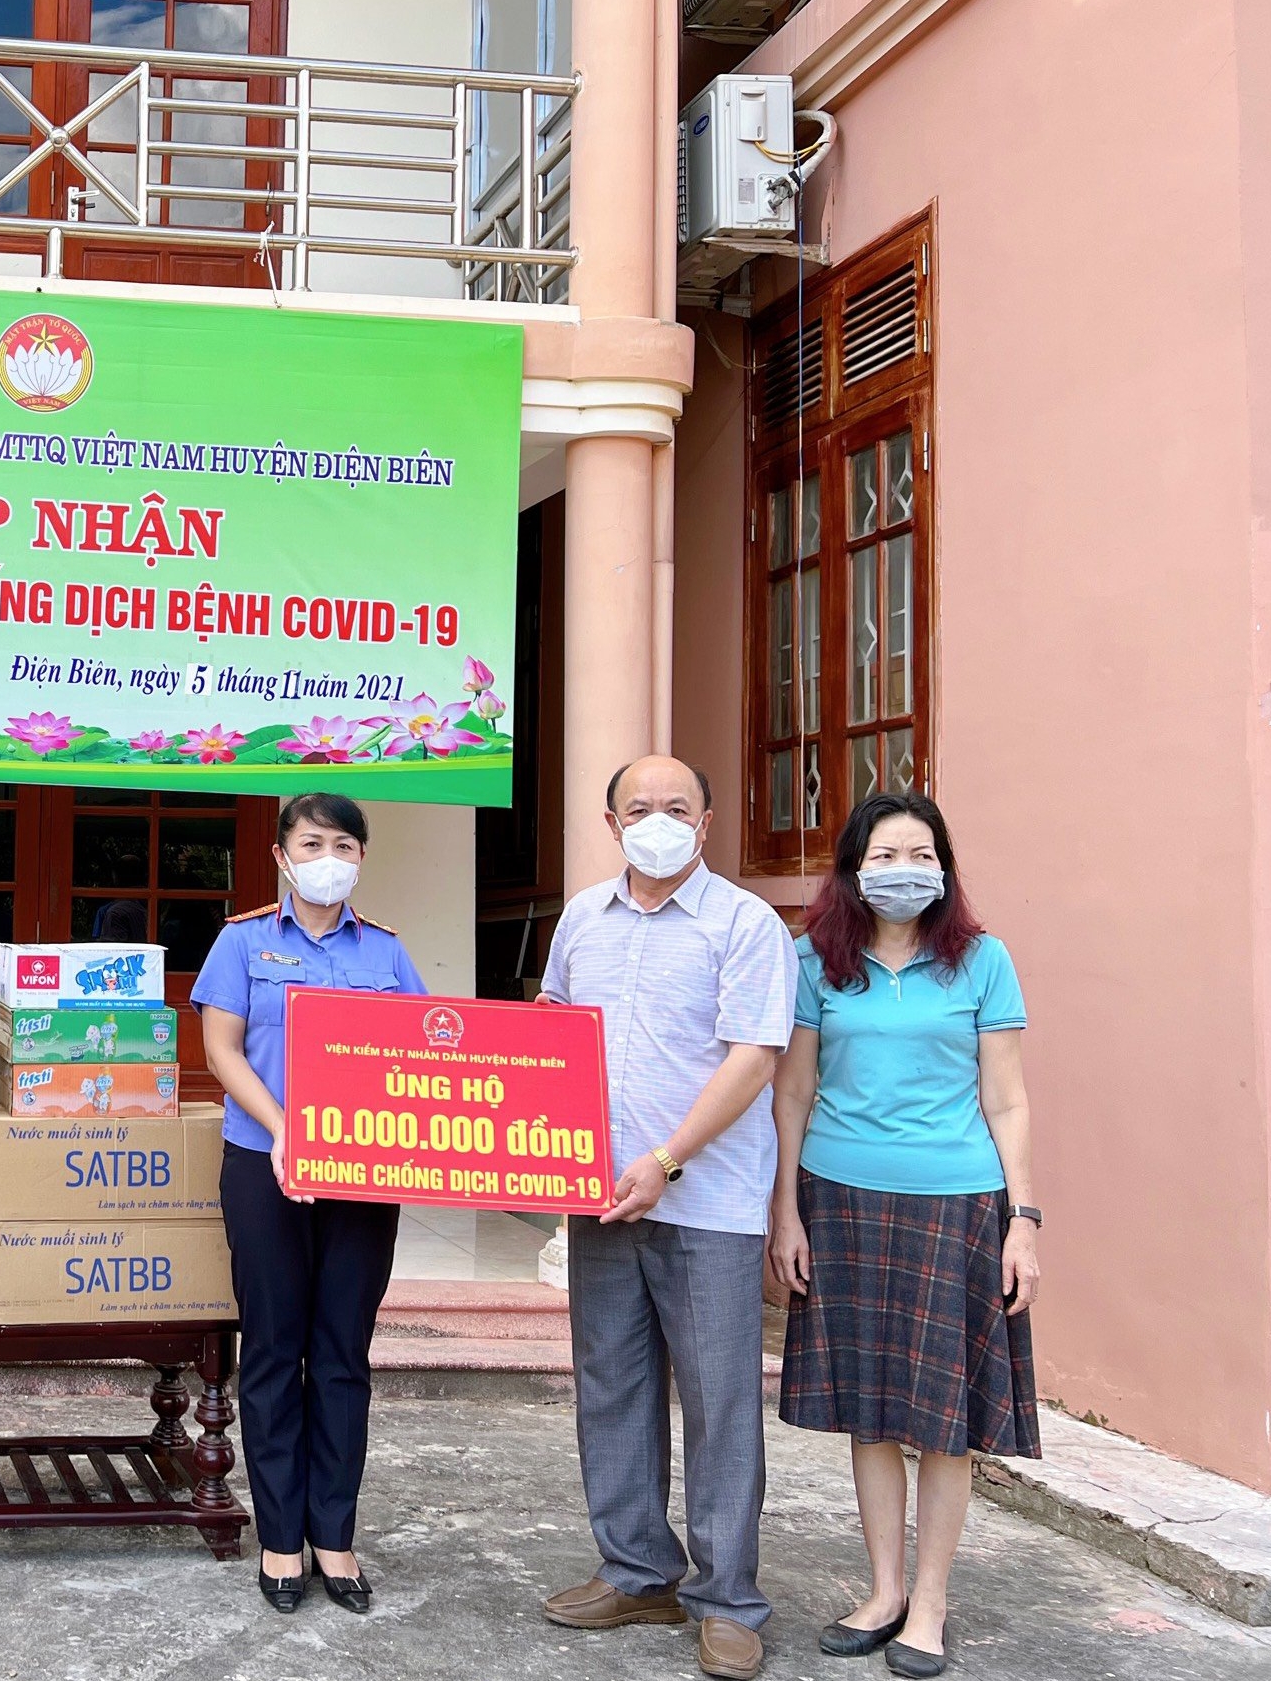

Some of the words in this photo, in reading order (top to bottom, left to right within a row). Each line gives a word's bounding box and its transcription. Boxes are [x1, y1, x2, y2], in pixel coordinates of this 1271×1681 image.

[72, 430, 137, 469] VIỆT
[141, 443, 206, 472] NAM
[209, 441, 307, 485] HUYỆN
[313, 445, 381, 489] ĐIỆN
[386, 450, 454, 487] BIÊN
[33, 491, 225, 567] NHẬN
[65, 583, 161, 637] DỊCH
[167, 582, 272, 642] BỆNH
[282, 595, 459, 648] COVID-19
[11, 654, 62, 686] Điện
[67, 658, 122, 692] Biên,
[129, 660, 180, 694] ngày
[191, 664, 206, 693] 5
[217, 665, 278, 701] tháng
[302, 671, 349, 700] năm
[354, 674, 404, 702] 2021
[22, 975, 55, 985] VIFON
[325, 1043, 351, 1056] VIỆN
[353, 1042, 380, 1057] KIỂM
[383, 1044, 405, 1058] SÁT
[407, 1048, 440, 1061] NHÂN
[442, 1050, 467, 1063] DÂN
[470, 1052, 508, 1067] HUYỆN
[510, 1054, 538, 1068] ĐIỆN
[540, 1055, 566, 1068] BIÊN
[385, 1065, 451, 1101] ỦNG
[462, 1075, 505, 1109] HỘ
[7, 1127, 43, 1140] Nước
[48, 1123, 81, 1140] muối
[85, 1127, 113, 1140] sinh
[116, 1127, 128, 1142] lý
[301, 1105, 495, 1154] 10.000.000
[507, 1114, 595, 1165] đồng
[65, 1151, 170, 1187] SATBB
[296, 1156, 366, 1186] PHÒNG
[373, 1157, 444, 1191] CHỐNG
[450, 1169, 500, 1198] DỊCH
[505, 1175, 603, 1200] COVID-19
[98, 1200, 116, 1209] Làm
[118, 1200, 135, 1210] sạch
[148, 1200, 169, 1208] chăm
[172, 1200, 184, 1208] sóc
[186, 1200, 204, 1210] răng
[0, 1234, 36, 1247] Nước
[41, 1229, 75, 1246] muối
[79, 1232, 107, 1245] sinh
[112, 1232, 124, 1248] lý
[66, 1256, 171, 1294] SATBB
[100, 1303, 118, 1312] Làm
[119, 1303, 137, 1313] sạch
[140, 1303, 148, 1311] và
[173, 1302, 185, 1310] sóc
[187, 1302, 205, 1312] răng
[208, 1300, 230, 1311] miệng
